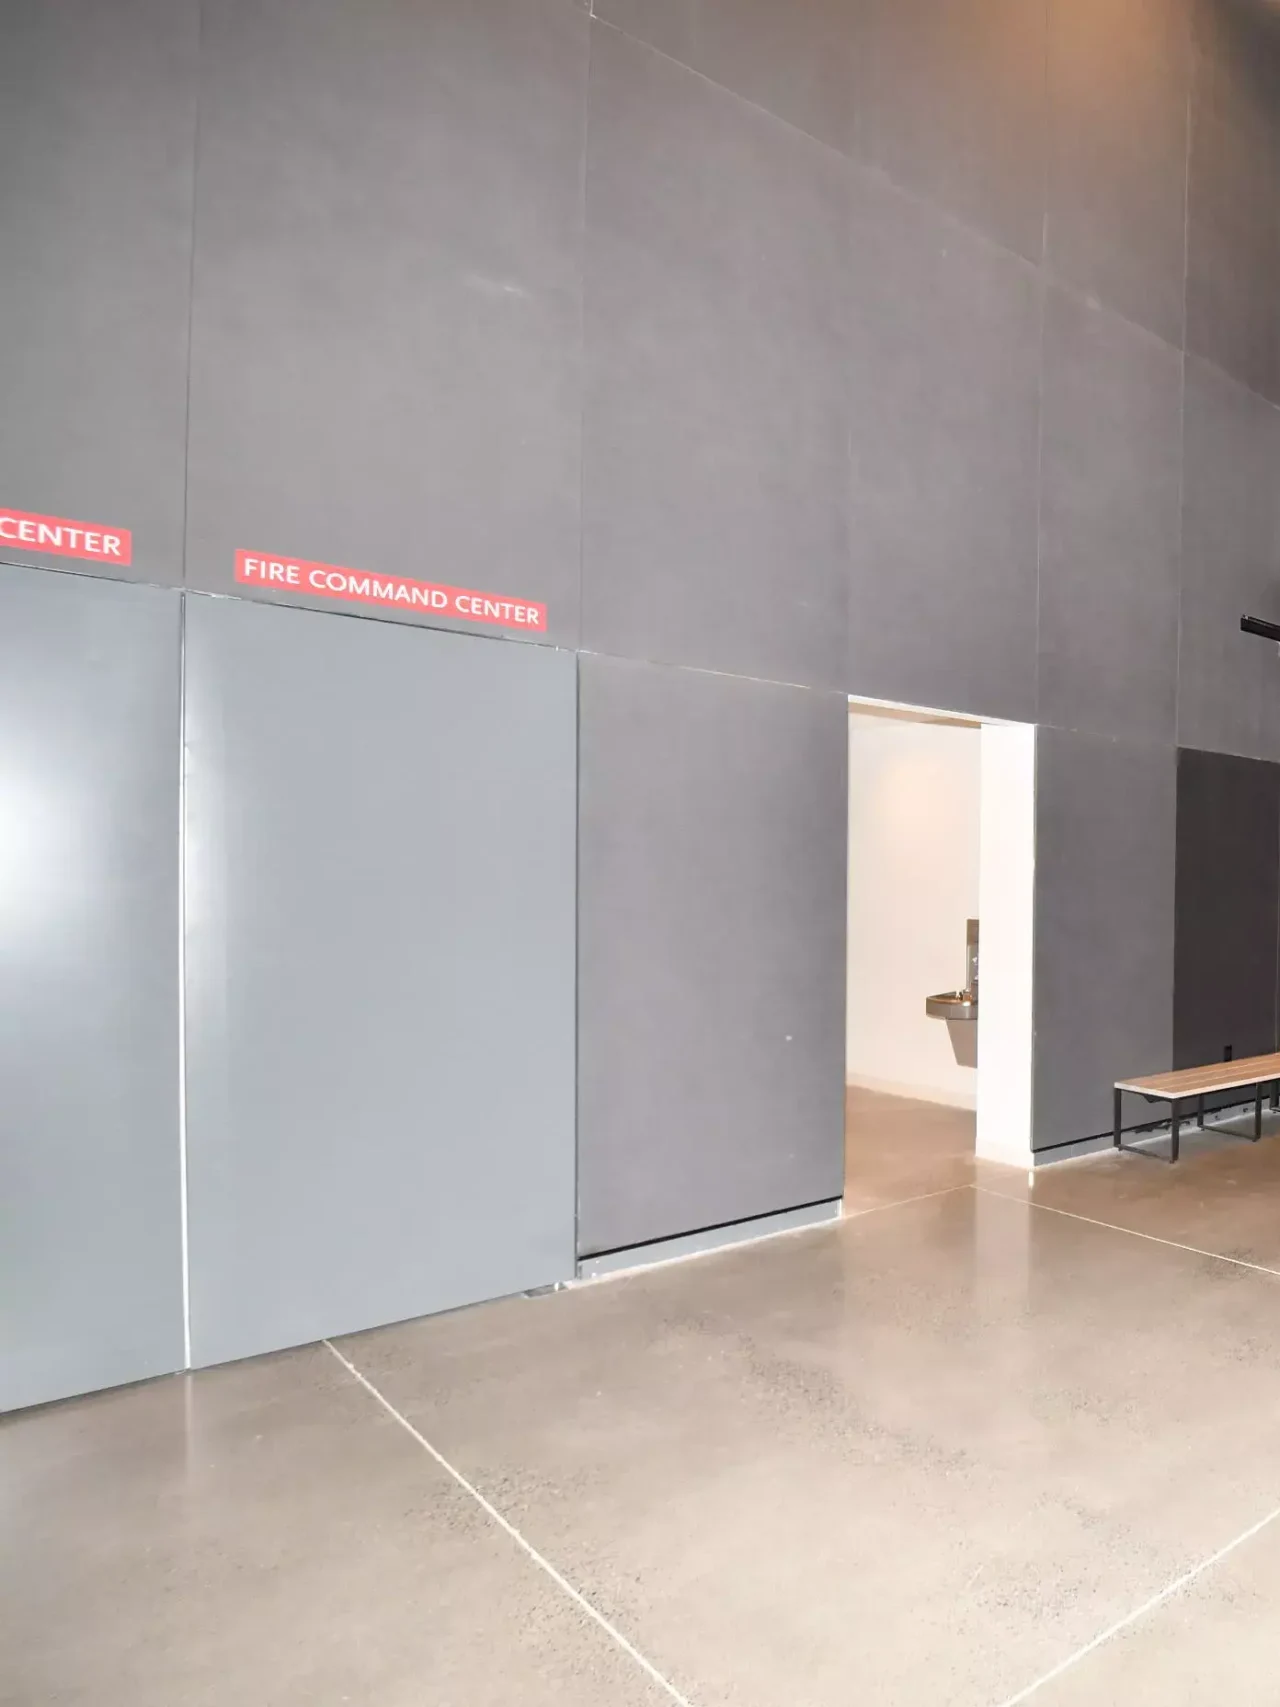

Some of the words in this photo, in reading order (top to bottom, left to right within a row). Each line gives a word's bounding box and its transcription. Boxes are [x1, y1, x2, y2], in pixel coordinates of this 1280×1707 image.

[0, 517, 121, 556] CENTER
[244, 558, 300, 585] FIRE
[308, 569, 448, 609] COMMAND
[455, 595, 539, 625] CENTER
